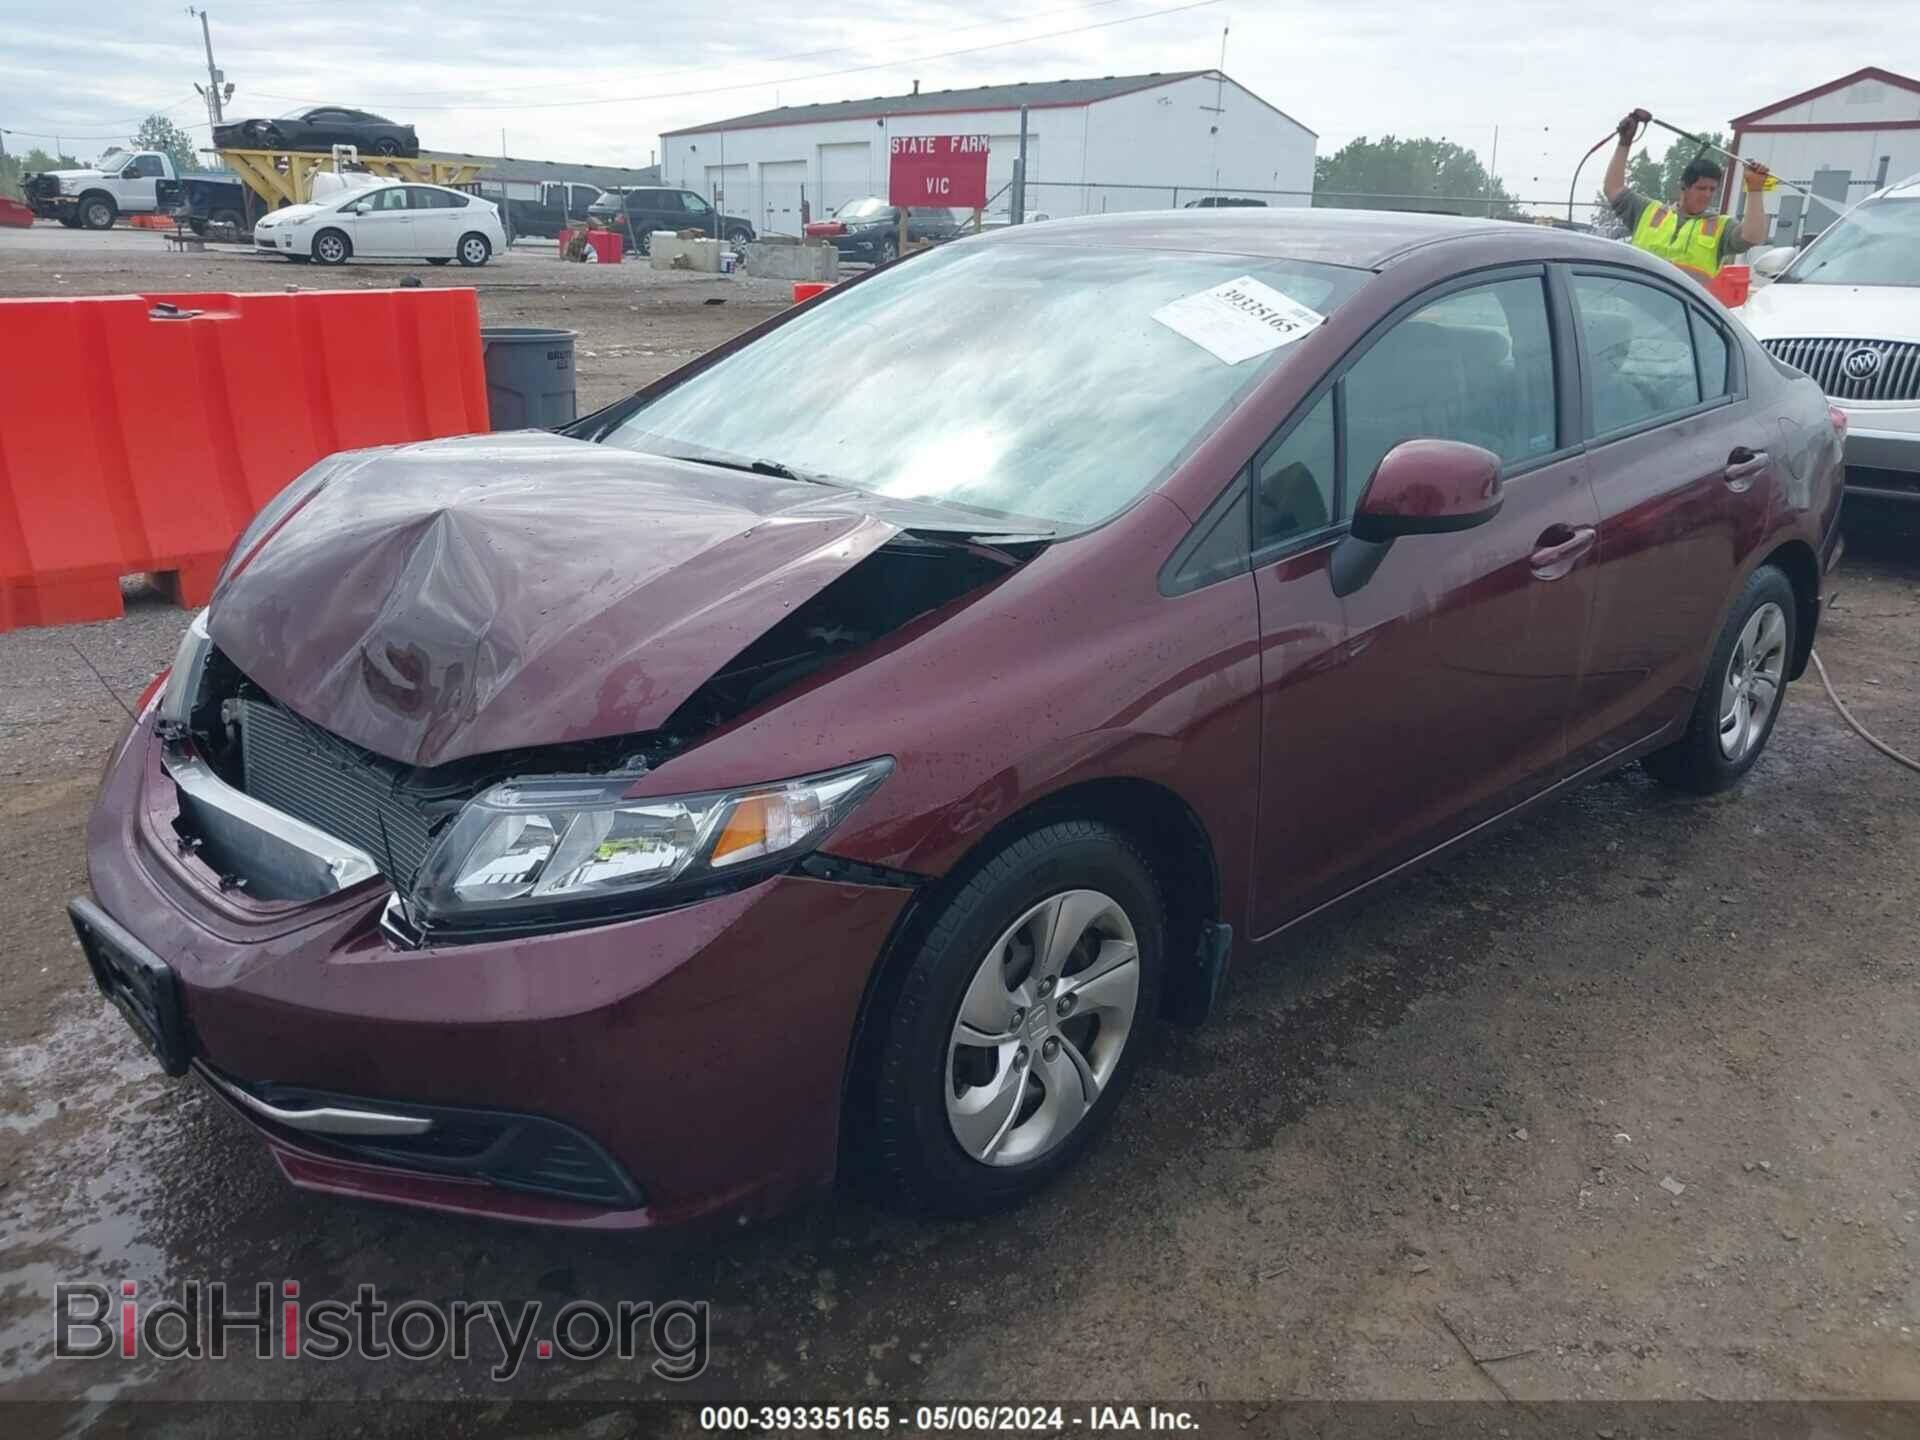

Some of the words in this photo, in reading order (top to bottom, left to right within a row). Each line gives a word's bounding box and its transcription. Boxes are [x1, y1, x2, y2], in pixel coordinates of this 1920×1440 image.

[891, 137, 936, 154] STATE
[950, 135, 989, 153] FARM
[926, 177, 950, 194] VIC
[1215, 288, 1301, 334] 39335165
